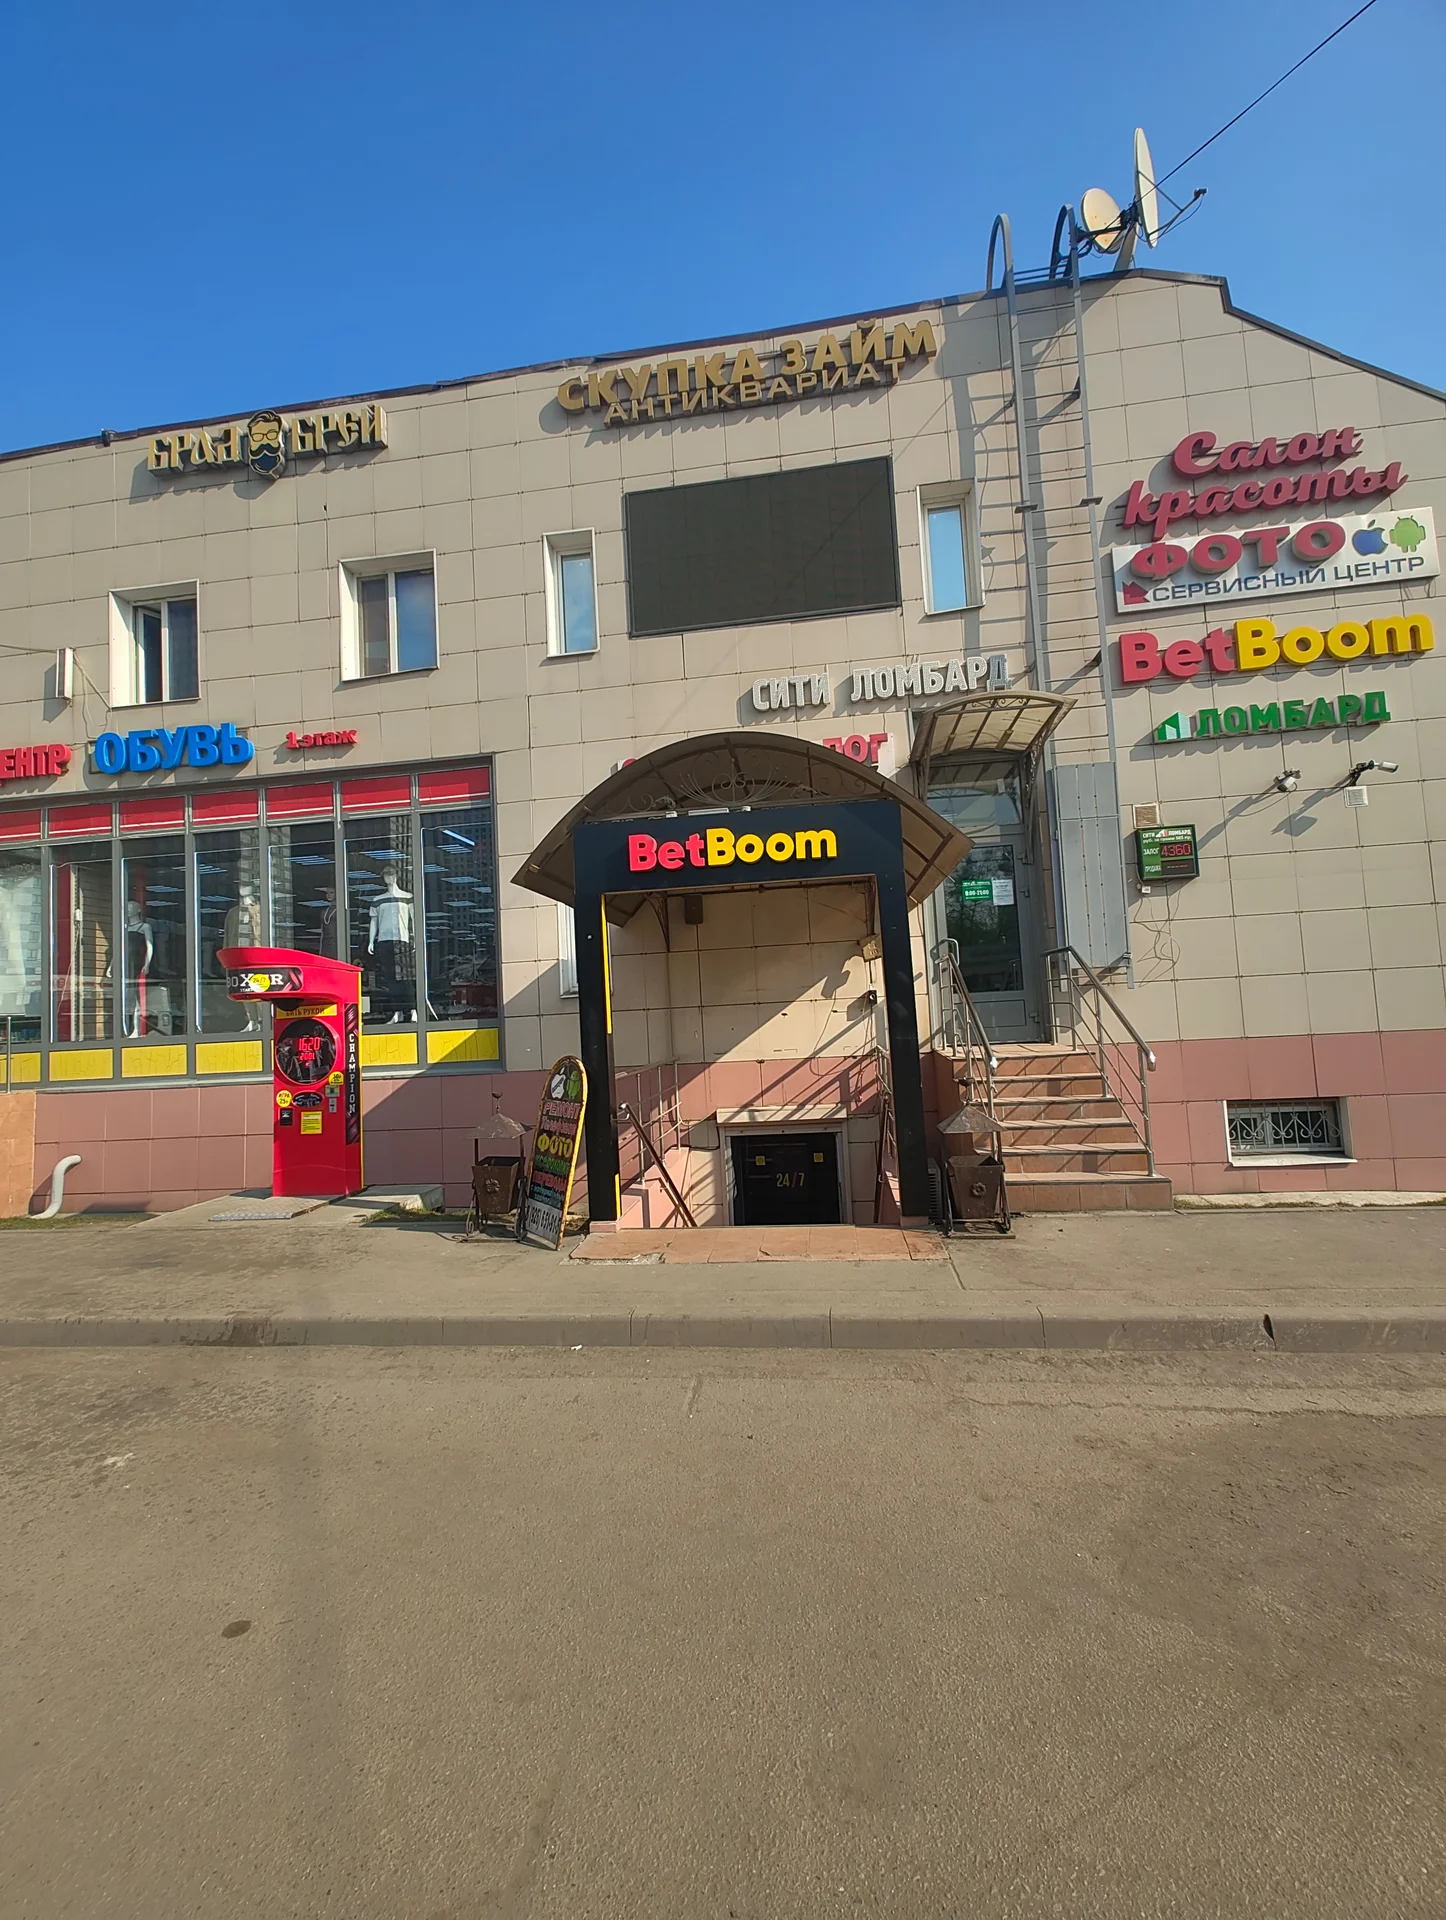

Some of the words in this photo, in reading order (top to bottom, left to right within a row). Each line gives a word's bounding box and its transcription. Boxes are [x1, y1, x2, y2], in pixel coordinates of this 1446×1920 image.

[557, 346, 765, 414] СКУПКА
[779, 318, 938, 376] ЗАЙМ
[603, 356, 908, 428] АНТИКВАРИАТ
[1169, 426, 1364, 480] Салон
[1120, 461, 1409, 542] красоты
[1129, 520, 1347, 581] ФОТО
[1151, 565, 1326, 603] СЕРВИСНЫЙ
[1333, 555, 1425, 583] ЦЕНТР
[1118, 613, 1435, 684] BetBoom
[752, 670, 832, 712] СИТИ
[850, 653, 1013, 703] ЛОМБАРД
[1195, 690, 1392, 739] ЛОМБАРД
[0, 743, 72, 786] ЕНТР
[94, 722, 255, 775] ОБУВЬ
[285, 731, 299, 750] 1
[300, 729, 359, 748] этаж
[627, 826, 838, 873] BetBoom
[1161, 844, 1191, 856] 4360
[348, 1033, 357, 1114] CHAMPION
[537, 1133, 574, 1159] ФОТО
[776, 1172, 805, 1189] 24/7
